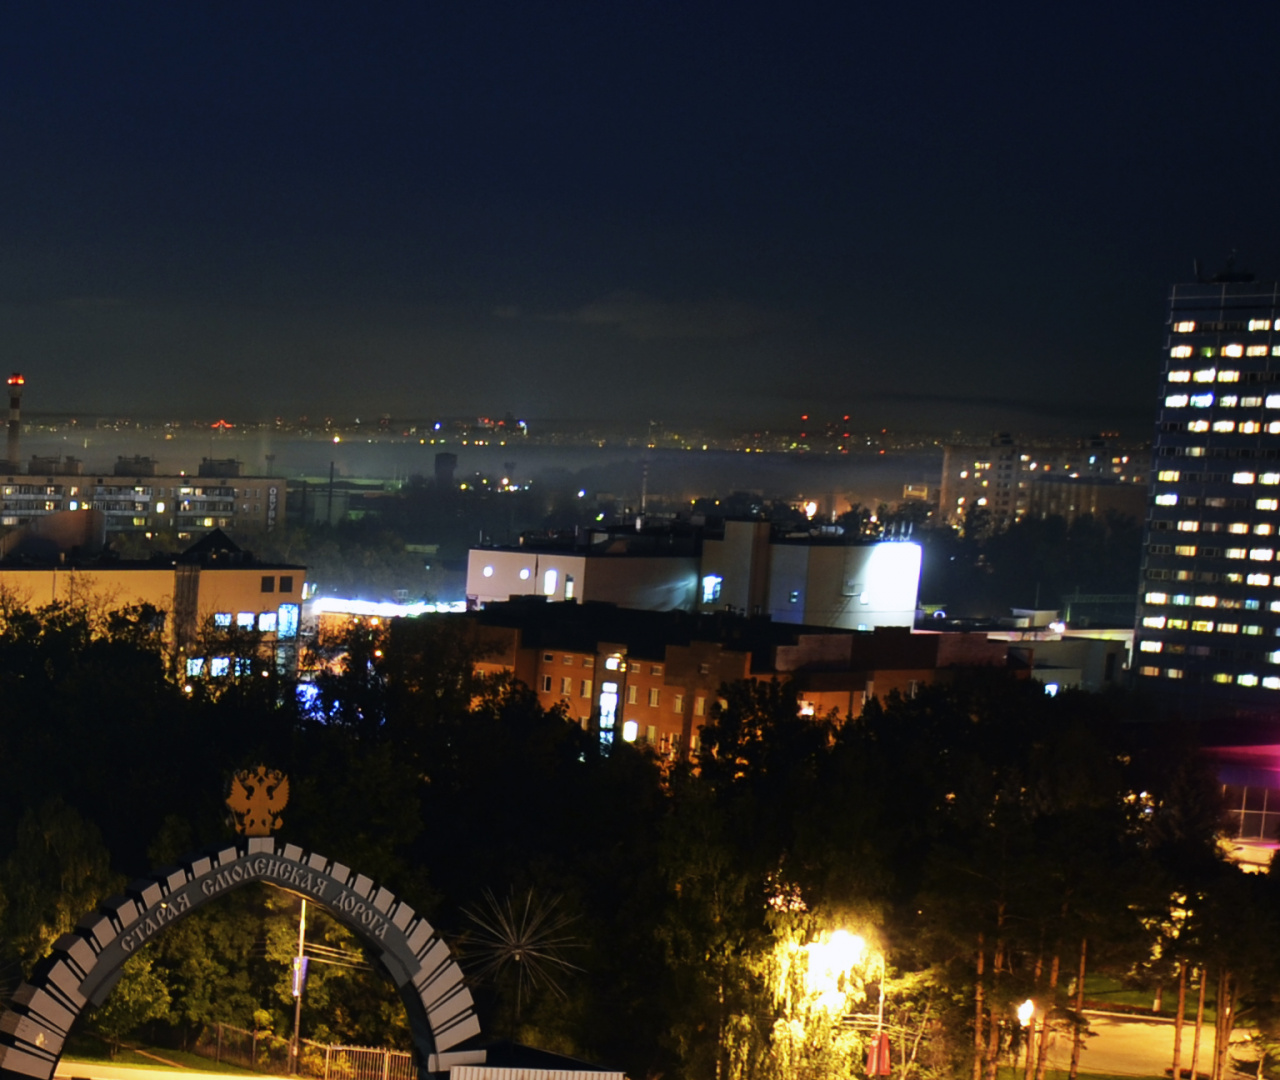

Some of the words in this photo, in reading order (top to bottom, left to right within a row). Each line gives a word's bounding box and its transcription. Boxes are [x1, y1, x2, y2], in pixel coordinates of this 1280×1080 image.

[121, 892, 191, 952] СТАРАЯ
[201, 858, 328, 897] СМОЛЕНСКАЯ
[333, 889, 391, 941] ДОРОГА
